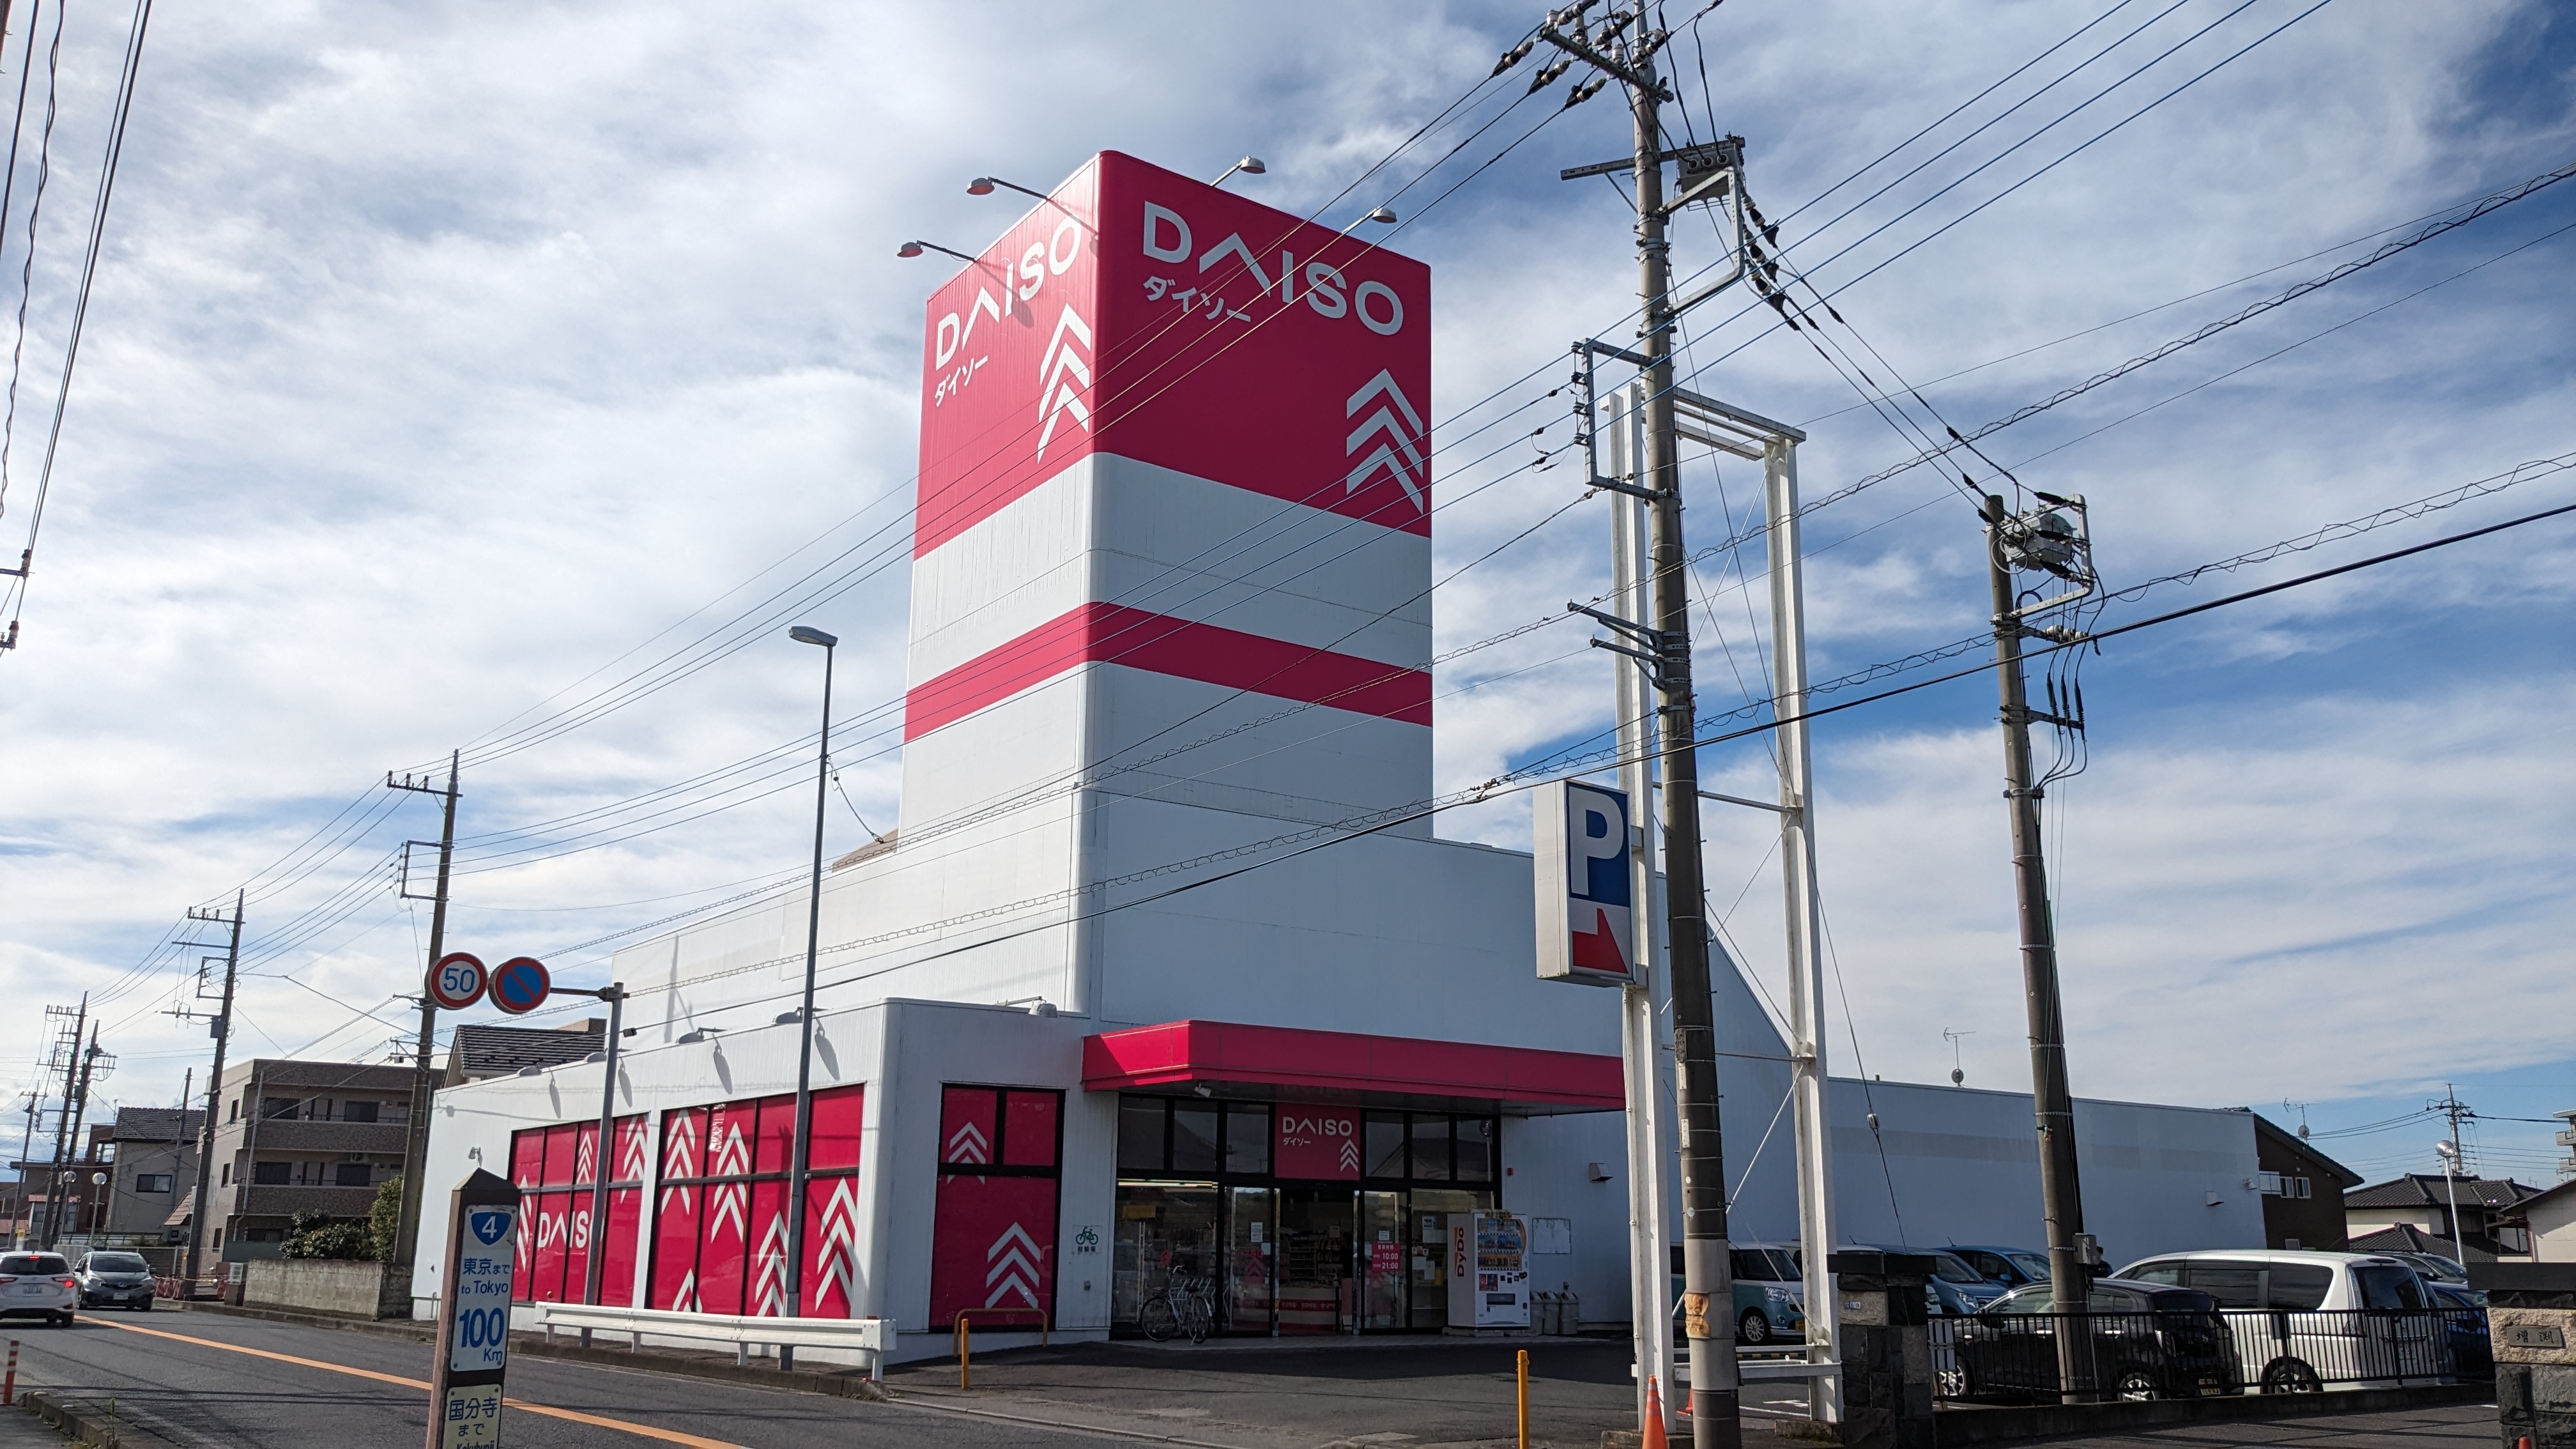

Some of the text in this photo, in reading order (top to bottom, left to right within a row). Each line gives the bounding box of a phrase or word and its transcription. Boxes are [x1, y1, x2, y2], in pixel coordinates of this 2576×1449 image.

[1144, 200, 1404, 335] DAISO
[936, 215, 1082, 371] DAISO
[1143, 275, 1251, 322] ダイソー
[935, 355, 988, 407] ダイソー
[1568, 785, 1624, 896] P
[443, 967, 475, 993] 50
[1283, 1116, 1353, 1136] DAISO
[1283, 1137, 1311, 1146] ダイソー
[482, 1215, 497, 1238] 4
[463, 1257, 510, 1275] 東京まで
[461, 1280, 509, 1296] to Tokyo
[459, 1308, 505, 1348] 100
[484, 1348, 503, 1361] Km
[449, 1397, 497, 1420] 国分寺
[459, 1423, 484, 1437] まで
